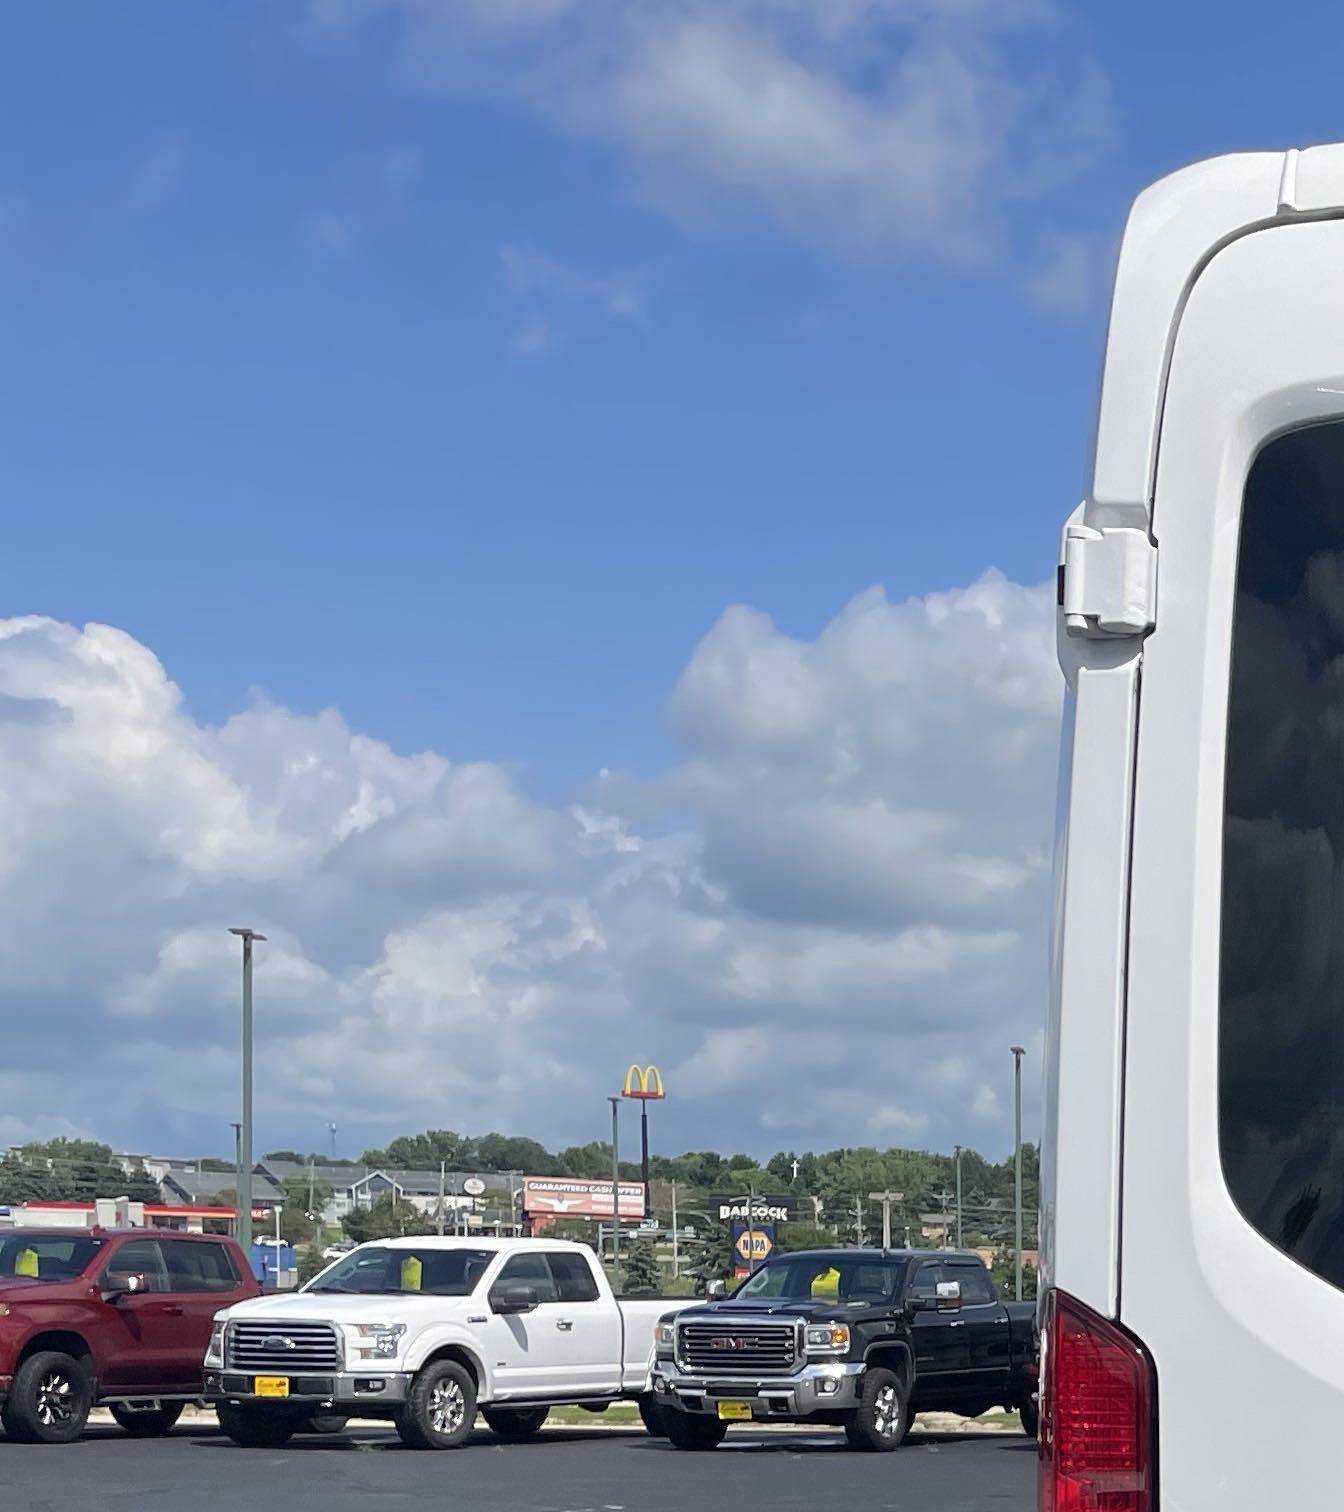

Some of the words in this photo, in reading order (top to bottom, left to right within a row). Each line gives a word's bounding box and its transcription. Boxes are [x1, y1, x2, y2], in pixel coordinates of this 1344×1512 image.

[529, 1183, 588, 1193] GUARANTEED
[719, 1205, 788, 1221] BABCOCK
[742, 1239, 766, 1252] NAPA
